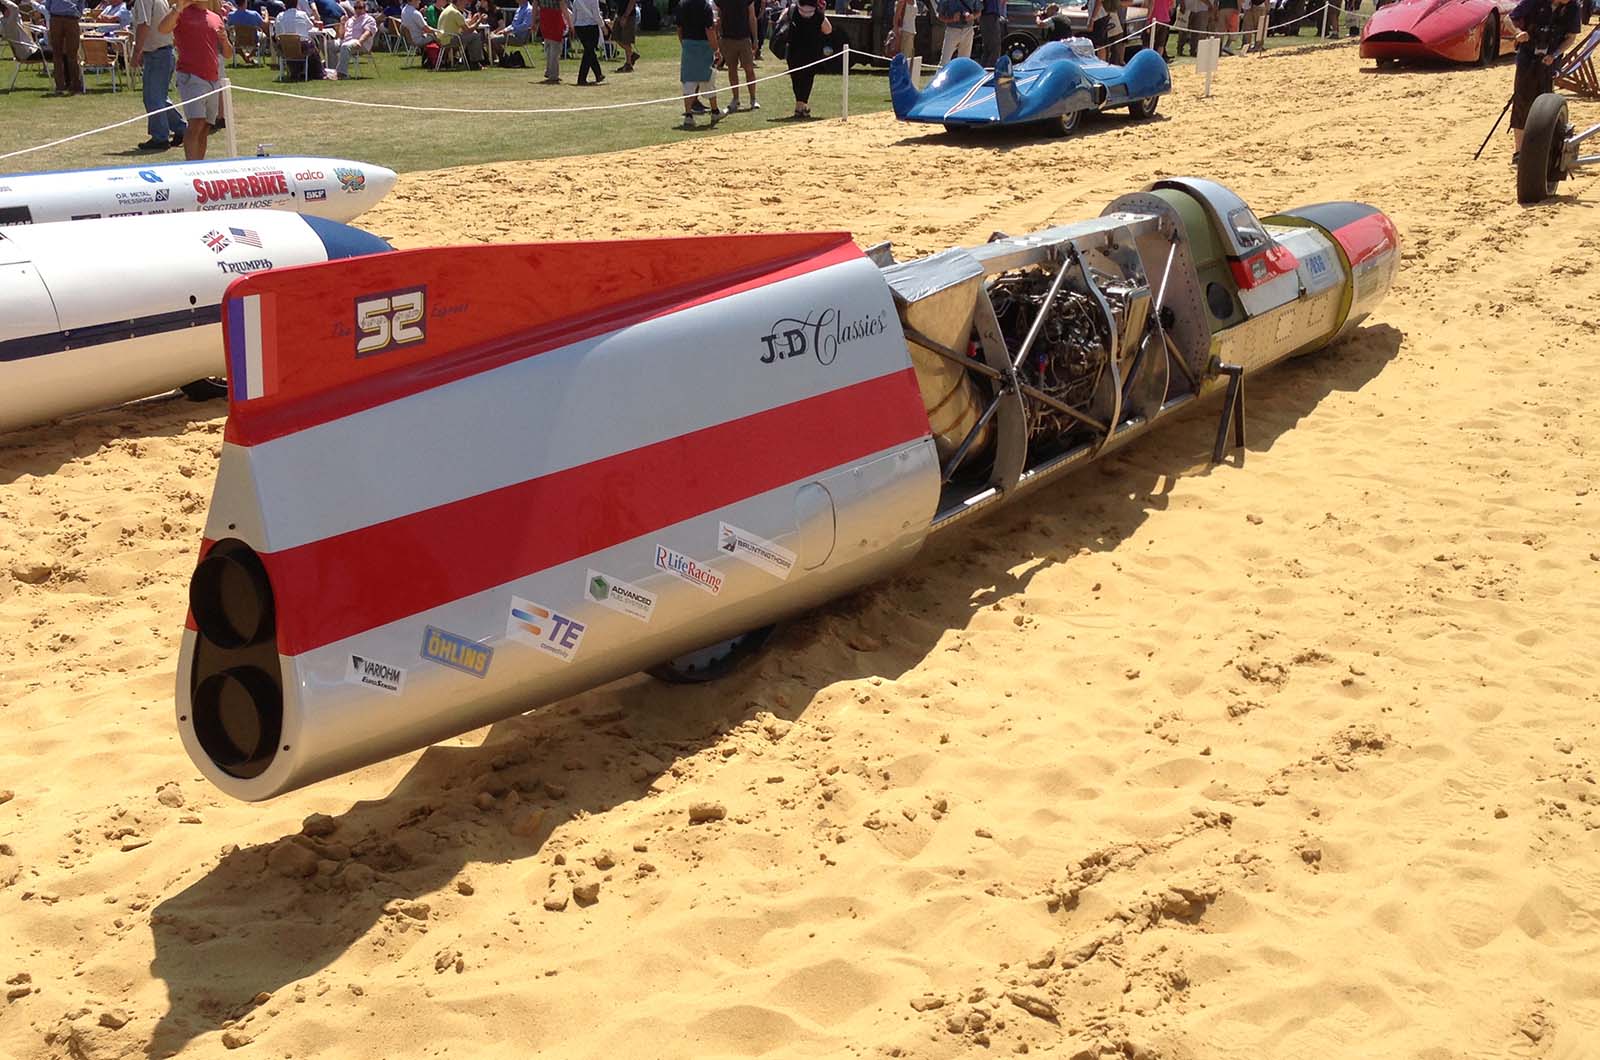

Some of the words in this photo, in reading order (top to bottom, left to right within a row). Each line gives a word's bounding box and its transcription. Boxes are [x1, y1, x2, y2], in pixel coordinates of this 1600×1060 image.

[295, 169, 324, 181] aalco
[193, 174, 289, 205] SUPERBIKE
[306, 190, 325, 199] SKF
[119, 197, 153, 205] PRESSINGS
[203, 202, 247, 211] SPECTRUM
[249, 199, 272, 209] HOSE
[217, 258, 273, 275] TRIUMPH
[357, 291, 425, 353] 52
[814, 308, 888, 366] Classics
[612, 585, 652, 606] ADVANCED
[548, 614, 585, 649] TE
[428, 631, 488, 673] ÖHLINS
[364, 660, 401, 684] VARIOHM
